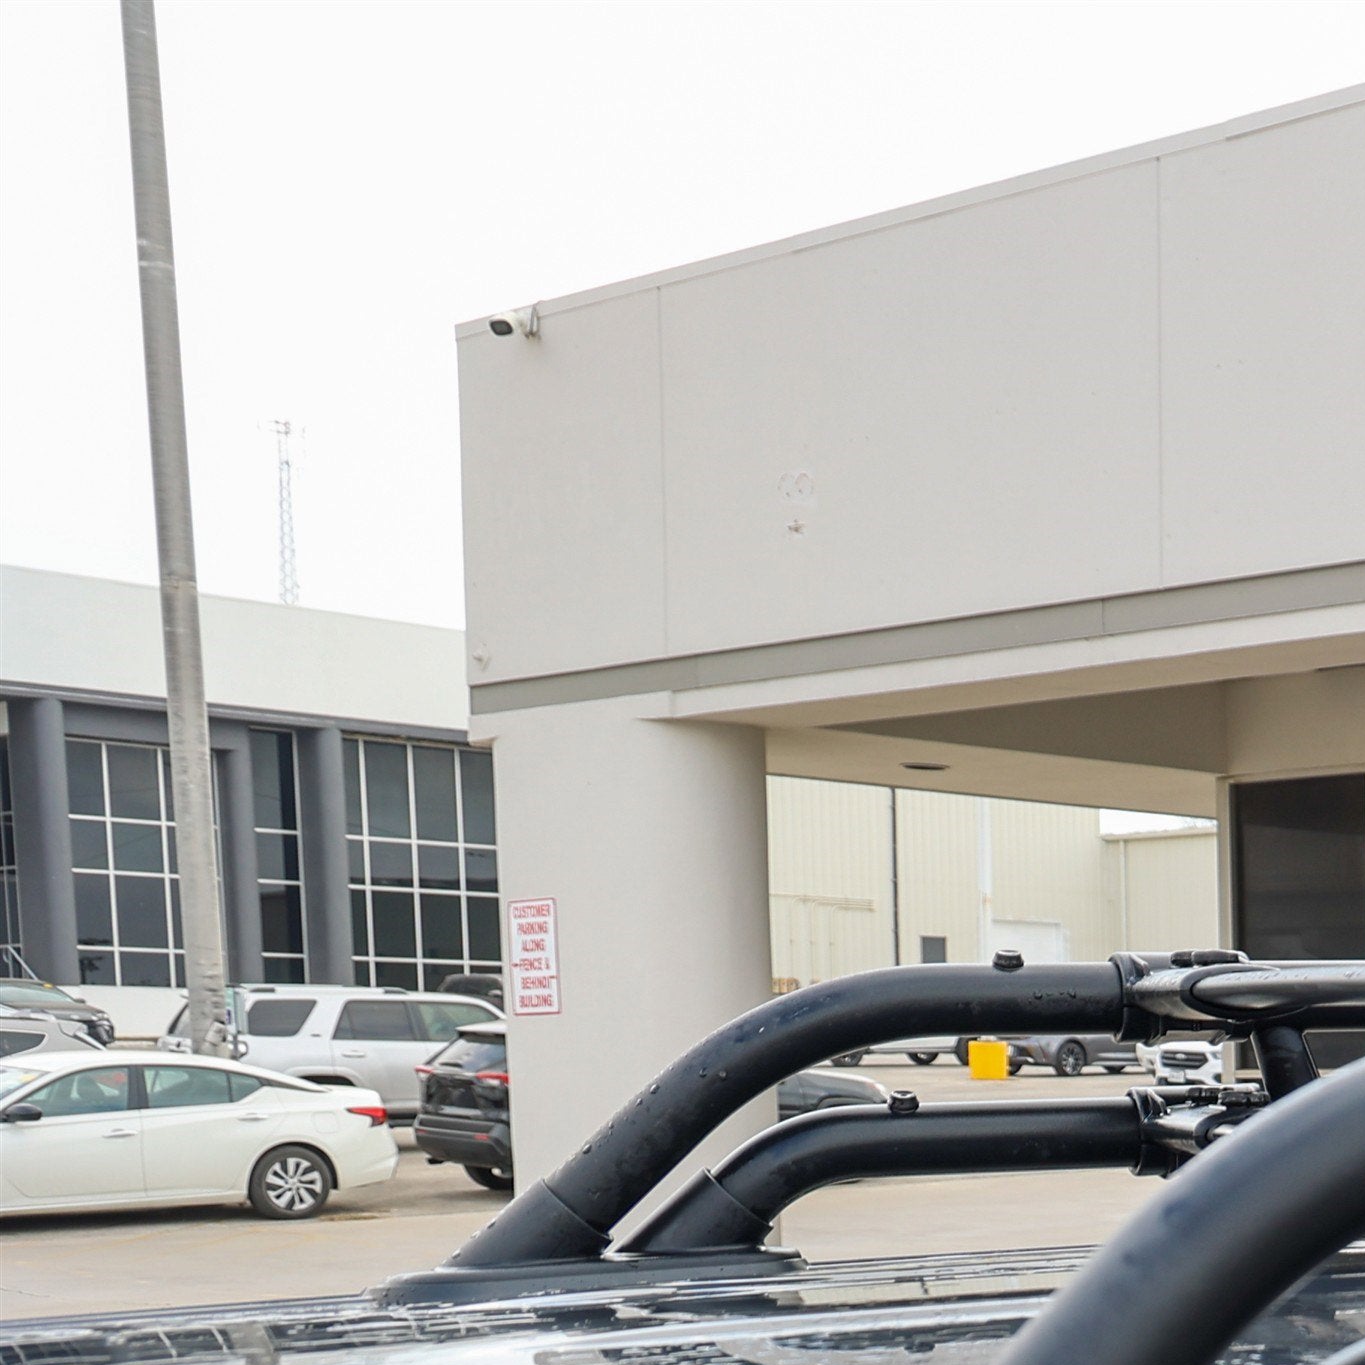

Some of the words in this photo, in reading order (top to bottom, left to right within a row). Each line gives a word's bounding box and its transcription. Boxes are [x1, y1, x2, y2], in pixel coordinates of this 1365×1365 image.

[513, 904, 550, 919] CUSTOMER
[518, 921, 547, 935] PARKING
[521, 939, 546, 952] ALONG
[519, 958, 542, 971] FENCE
[519, 995, 552, 1008] BUILDING
